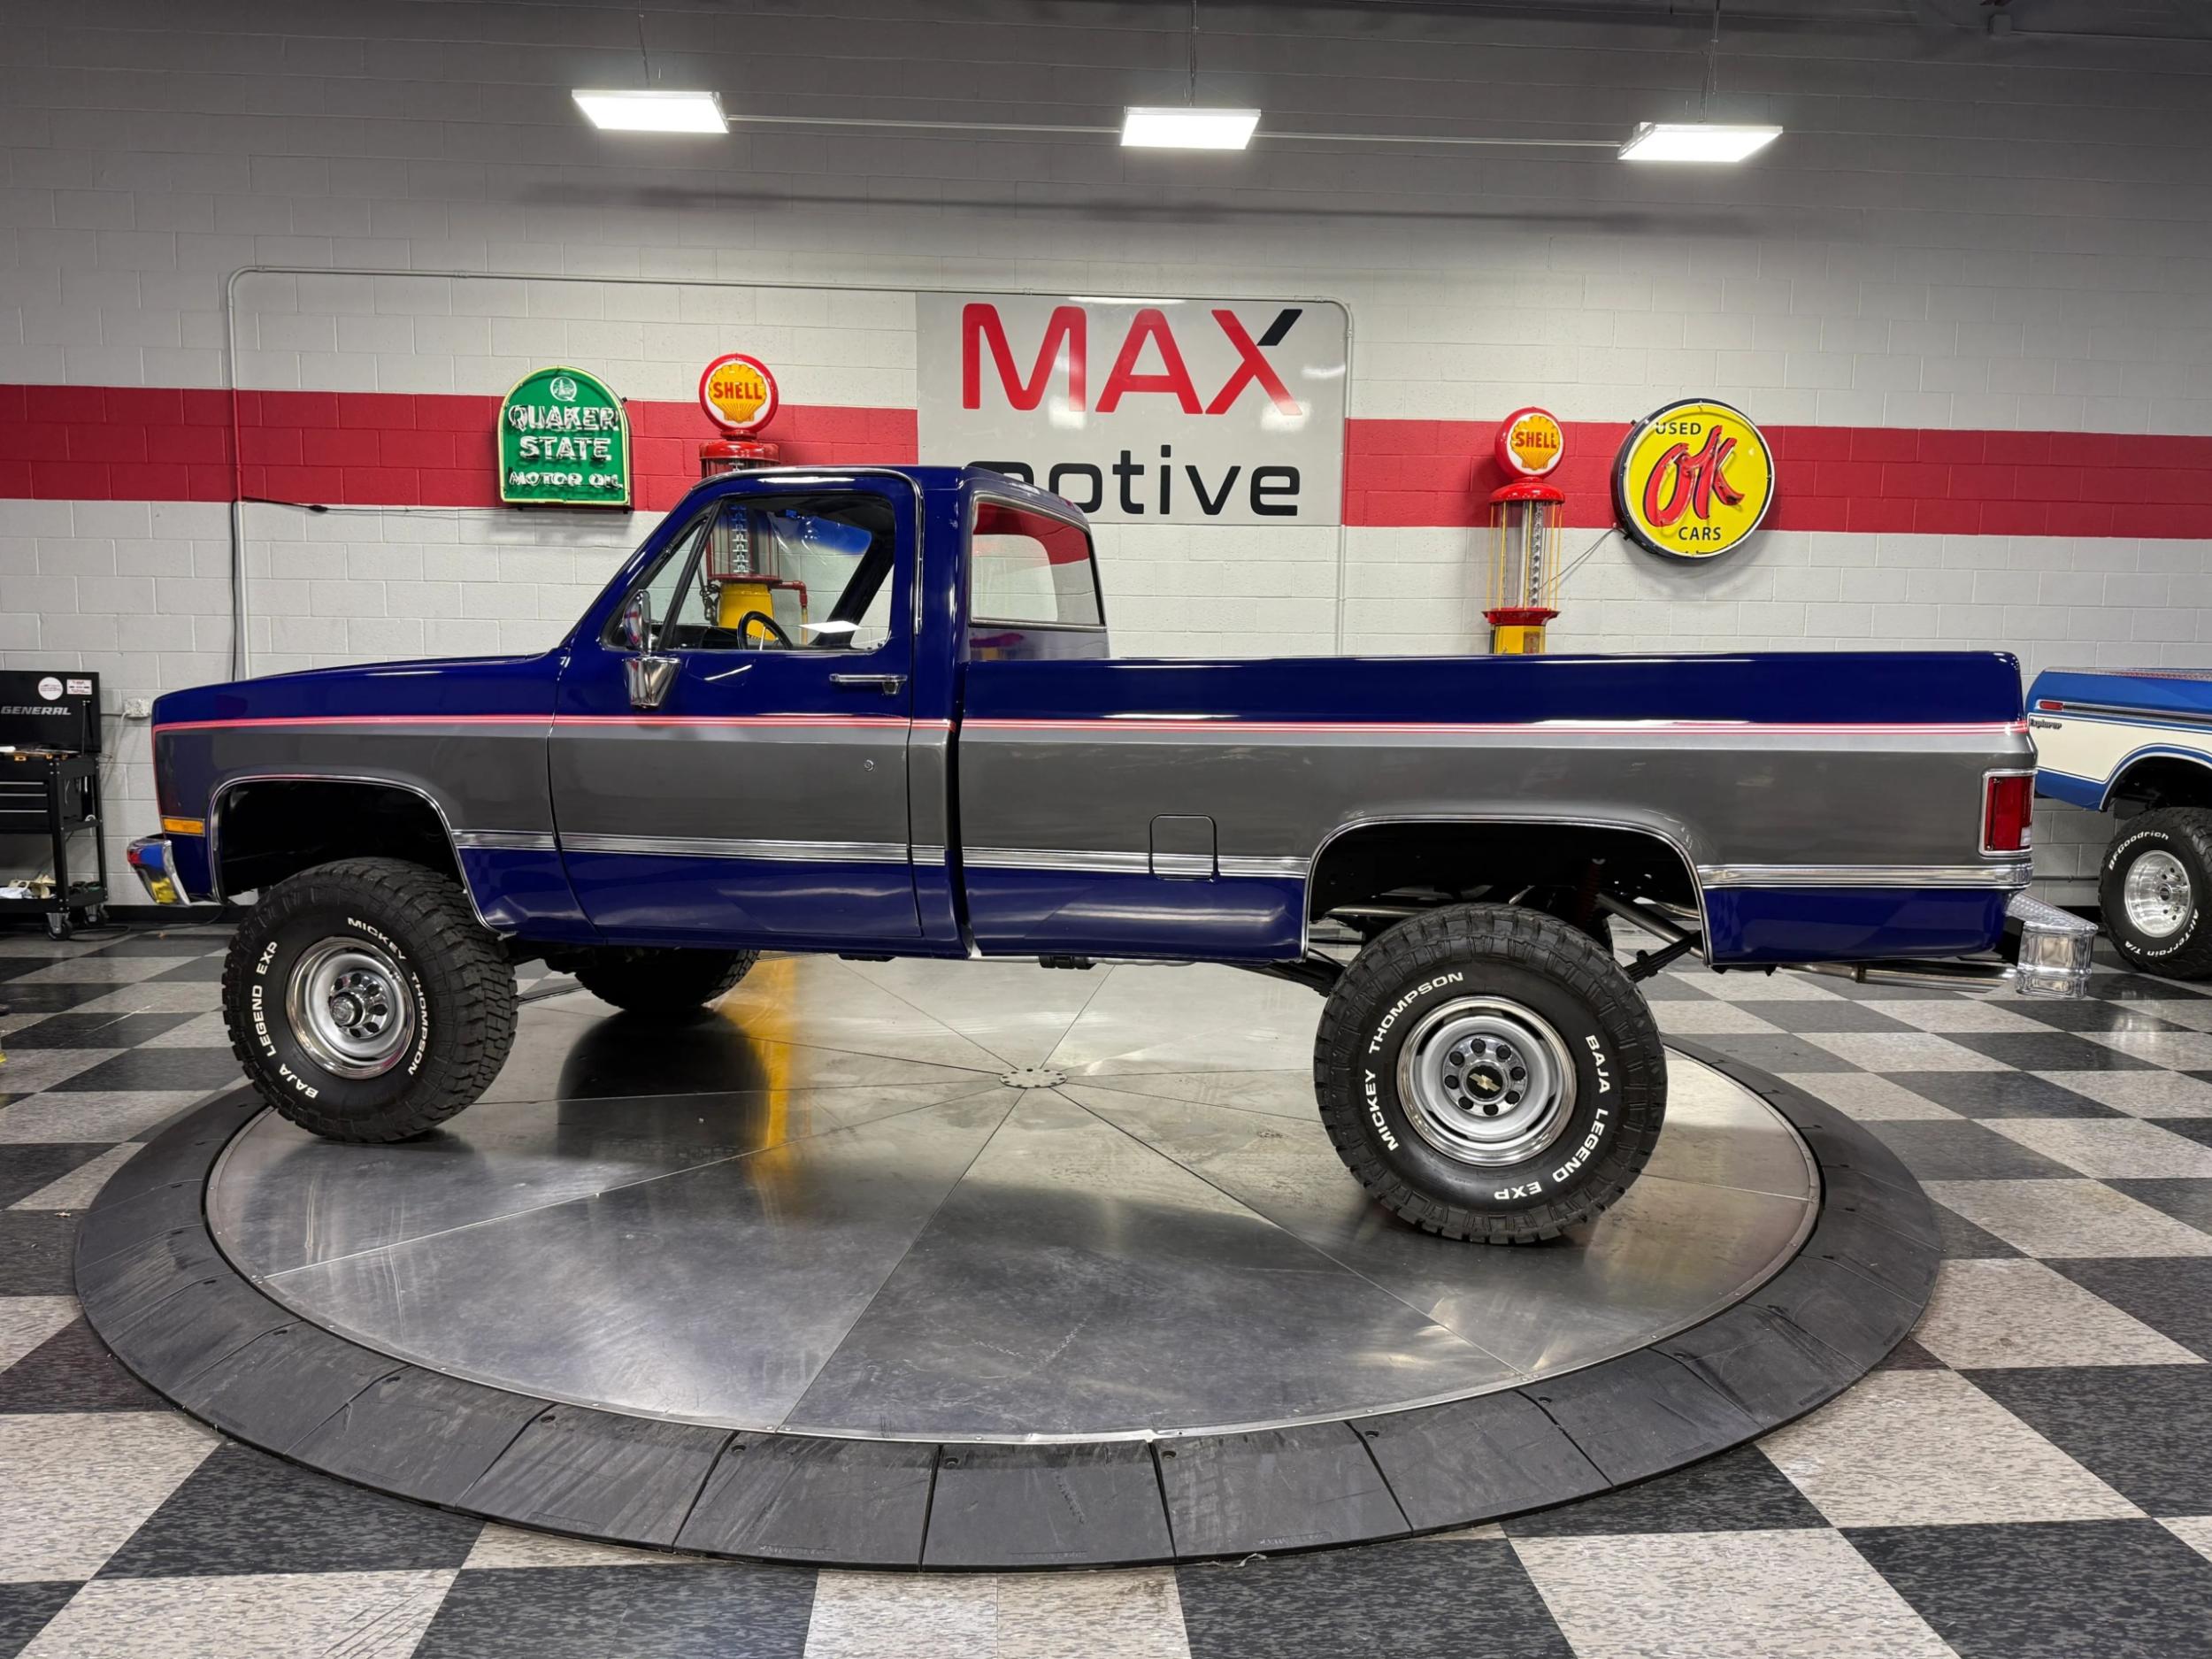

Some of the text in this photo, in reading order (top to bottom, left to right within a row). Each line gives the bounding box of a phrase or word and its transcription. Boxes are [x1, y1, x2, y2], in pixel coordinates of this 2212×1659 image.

[963, 303, 1302, 415] MAX
[712, 381, 763, 400] SHELL
[509, 404, 618, 432] QUAKER
[1655, 422, 1701, 435] USED
[519, 435, 612, 461] STATE
[1516, 431, 1556, 449] SHELL
[510, 471, 623, 488] MOTOR OIL
[1644, 425, 1745, 526] OK
[1678, 526, 1721, 541] CARS
[0, 706, 71, 716] GENERAL
[2030, 718, 2062, 730] Explorer
[2108, 830, 2170, 871] BFGoodrich
[2124, 908, 2199, 957] All-Terrain T/A
[347, 917, 432, 1077] MICKEY THOMPSON
[251, 941, 319, 1099] BAJA LEGEND EXP
[1365, 972, 1463, 1151] MICKEY THOMPSON
[1494, 1034, 1611, 1201] BAJA LEGEND EXP
